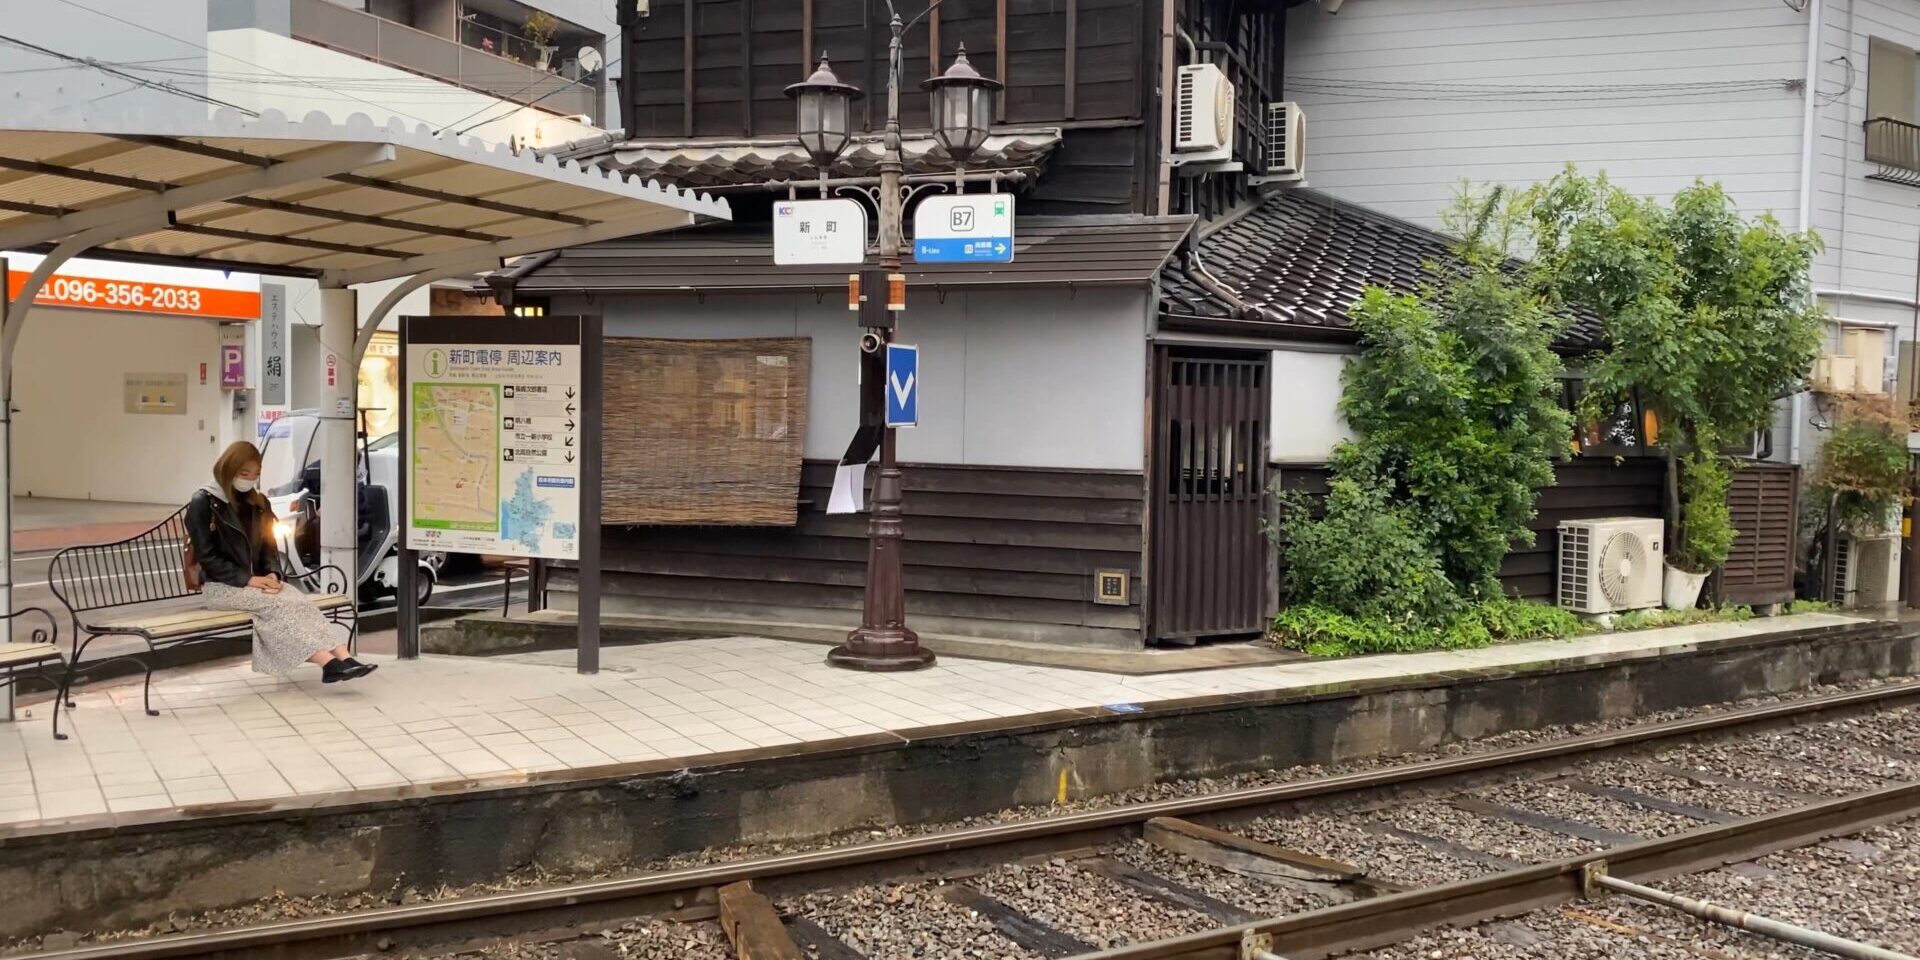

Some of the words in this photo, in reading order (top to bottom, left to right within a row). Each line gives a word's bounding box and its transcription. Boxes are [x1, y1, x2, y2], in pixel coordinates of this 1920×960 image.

[799, 221, 837, 233] 新町
[953, 212, 972, 226] B7
[24, 278, 201, 310] EL096-356-2033
[271, 295, 280, 349] エステハウス
[224, 349, 241, 373] P
[266, 355, 282, 377] 絹
[449, 349, 502, 366] 新町電停
[507, 350, 562, 366] 周辺案内
